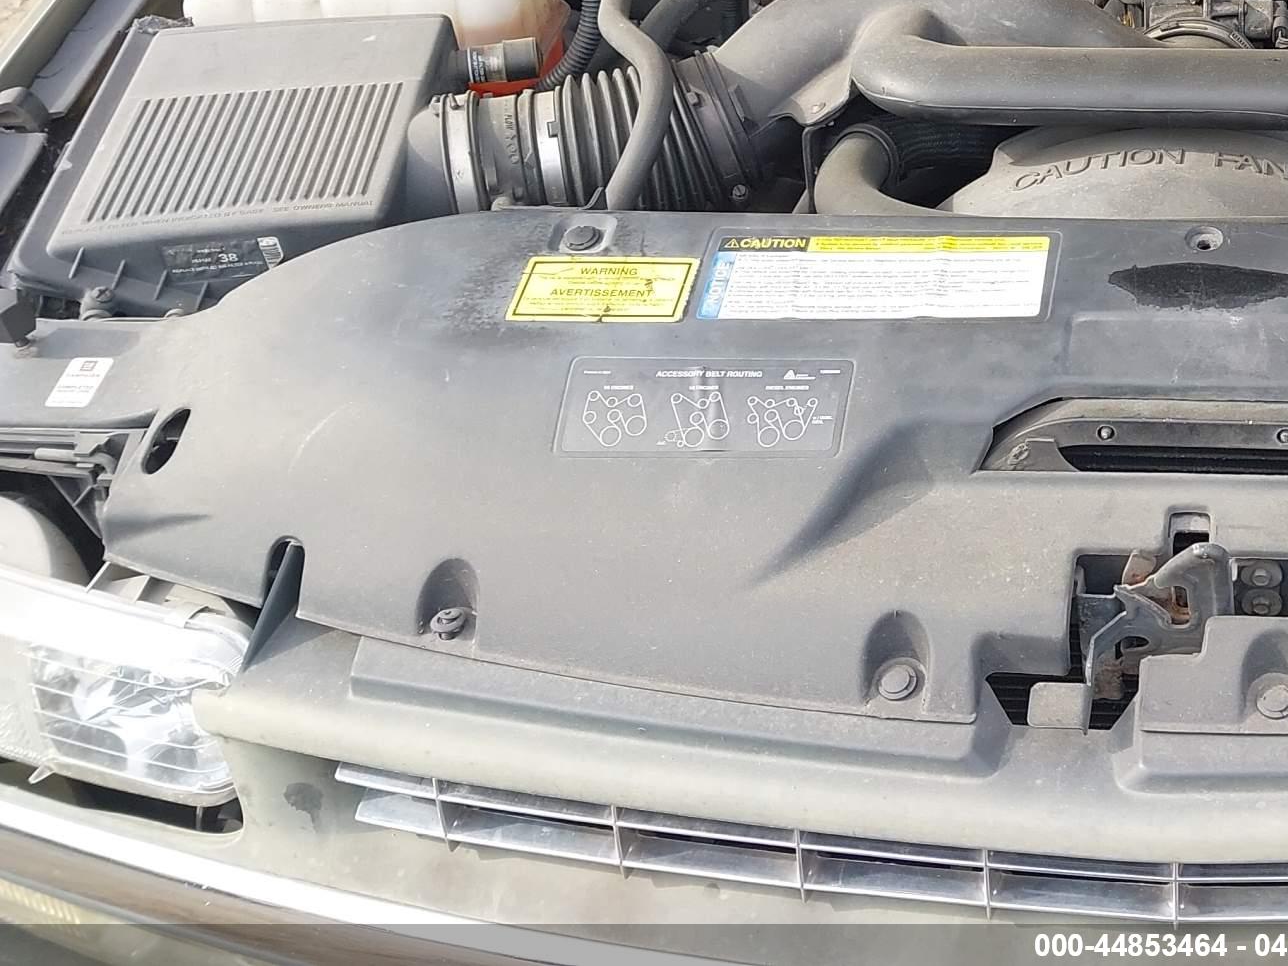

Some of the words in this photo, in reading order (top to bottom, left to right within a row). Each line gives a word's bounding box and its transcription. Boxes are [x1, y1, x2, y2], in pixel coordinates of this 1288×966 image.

[1011, 146, 1187, 192] CAUTION
[739, 237, 807, 249] CAUTION
[217, 253, 240, 263] 38
[580, 267, 638, 276] WARNING
[707, 261, 733, 305] NOTICE
[550, 288, 652, 297] AVERTISSEMENT
[655, 370, 704, 378] ACCESSORY
[726, 370, 763, 378] ROUTING
